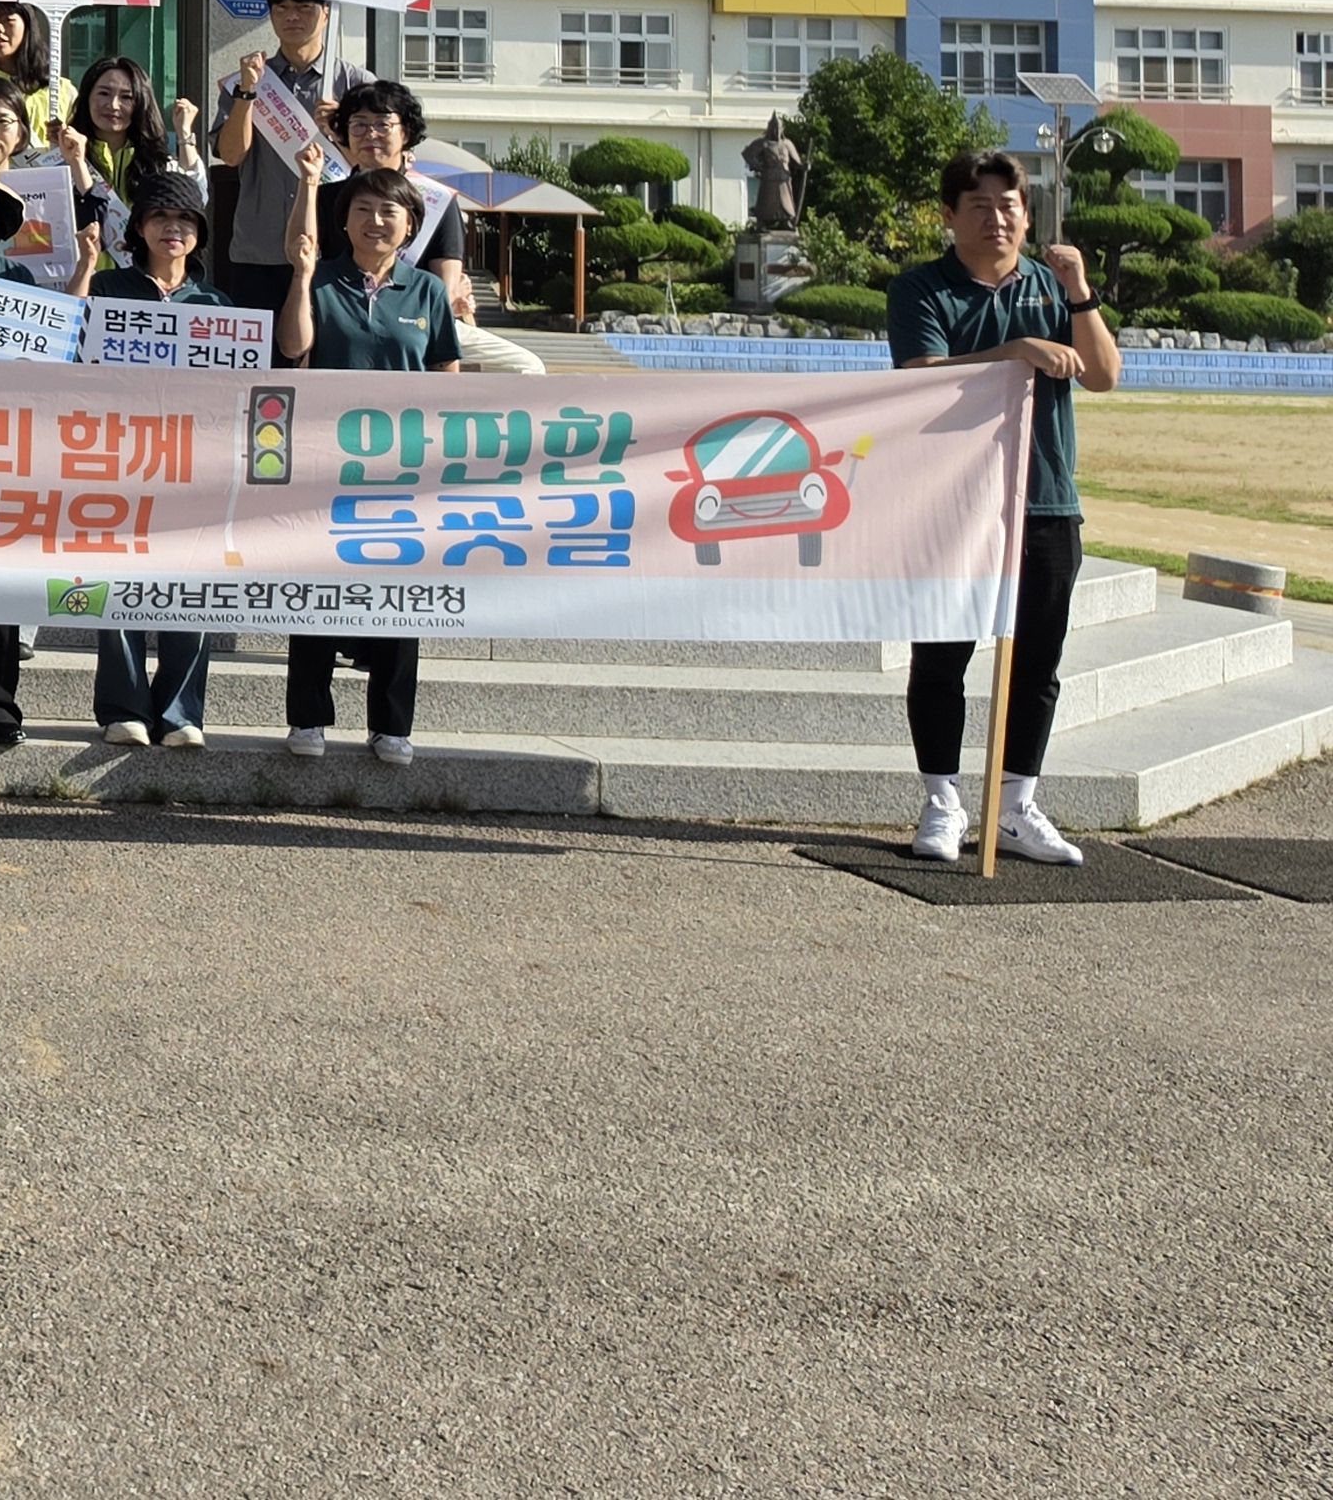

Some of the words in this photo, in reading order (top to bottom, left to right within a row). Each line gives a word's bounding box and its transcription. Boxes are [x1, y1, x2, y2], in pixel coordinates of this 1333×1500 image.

[102, 337, 177, 367] 천천히
[187, 344, 262, 369] 건너요
[104, 309, 179, 337] 멈추고
[188, 315, 264, 343] 살피고
[57, 408, 195, 484] 함께
[337, 406, 637, 485] 안전한
[328, 489, 635, 567] 등굣길
[110, 611, 246, 625] GYEONGSANGNAMDO
[251, 613, 316, 626] HAMYANG
[323, 615, 366, 627] OFFICE
[371, 616, 391, 627] OF
[391, 616, 466, 629] EDUCATION
